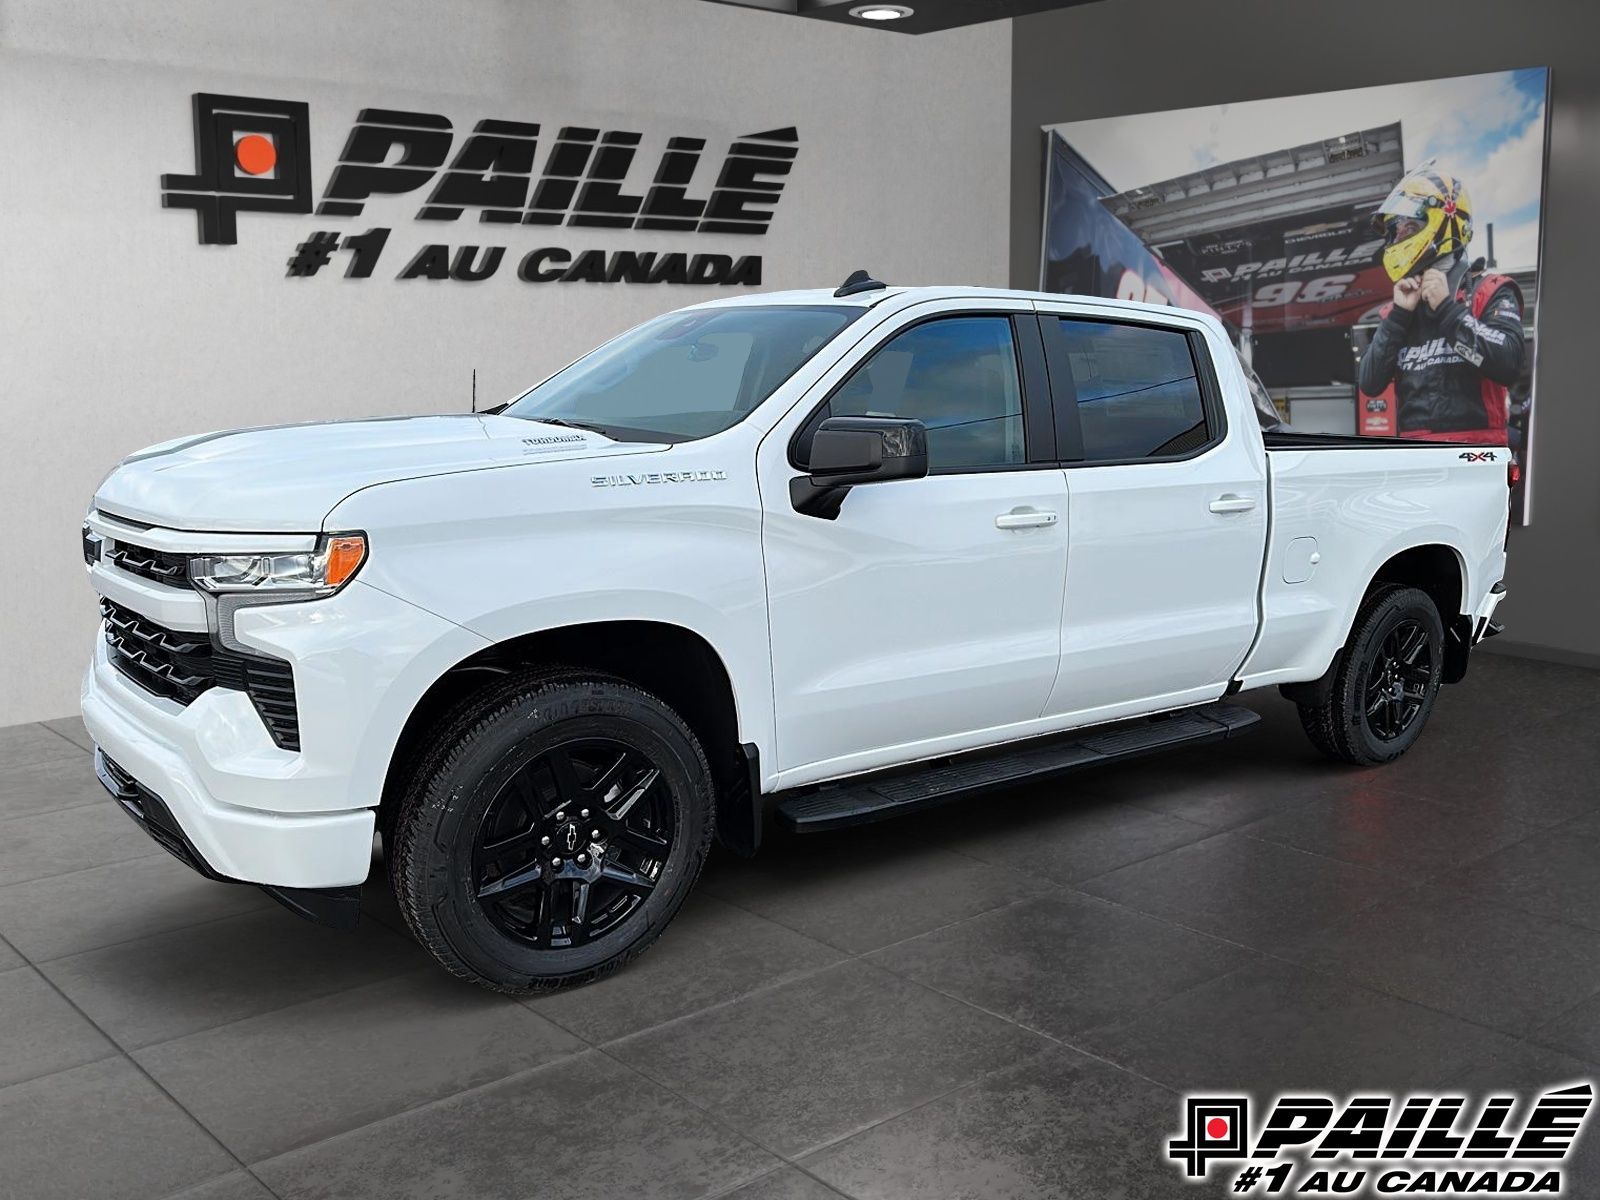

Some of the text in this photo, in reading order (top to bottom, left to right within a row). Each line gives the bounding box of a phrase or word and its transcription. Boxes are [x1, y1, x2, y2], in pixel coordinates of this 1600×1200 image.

[315, 108, 799, 236] PAILLÉ
[1284, 228, 1353, 244] CHEVROLET
[286, 227, 762, 286] #1 AU CANADA
[1256, 270, 1282, 279] AU
[1288, 256, 1373, 274] CANADA
[1252, 274, 1356, 308] 96
[590, 470, 728, 488] SILVERADO
